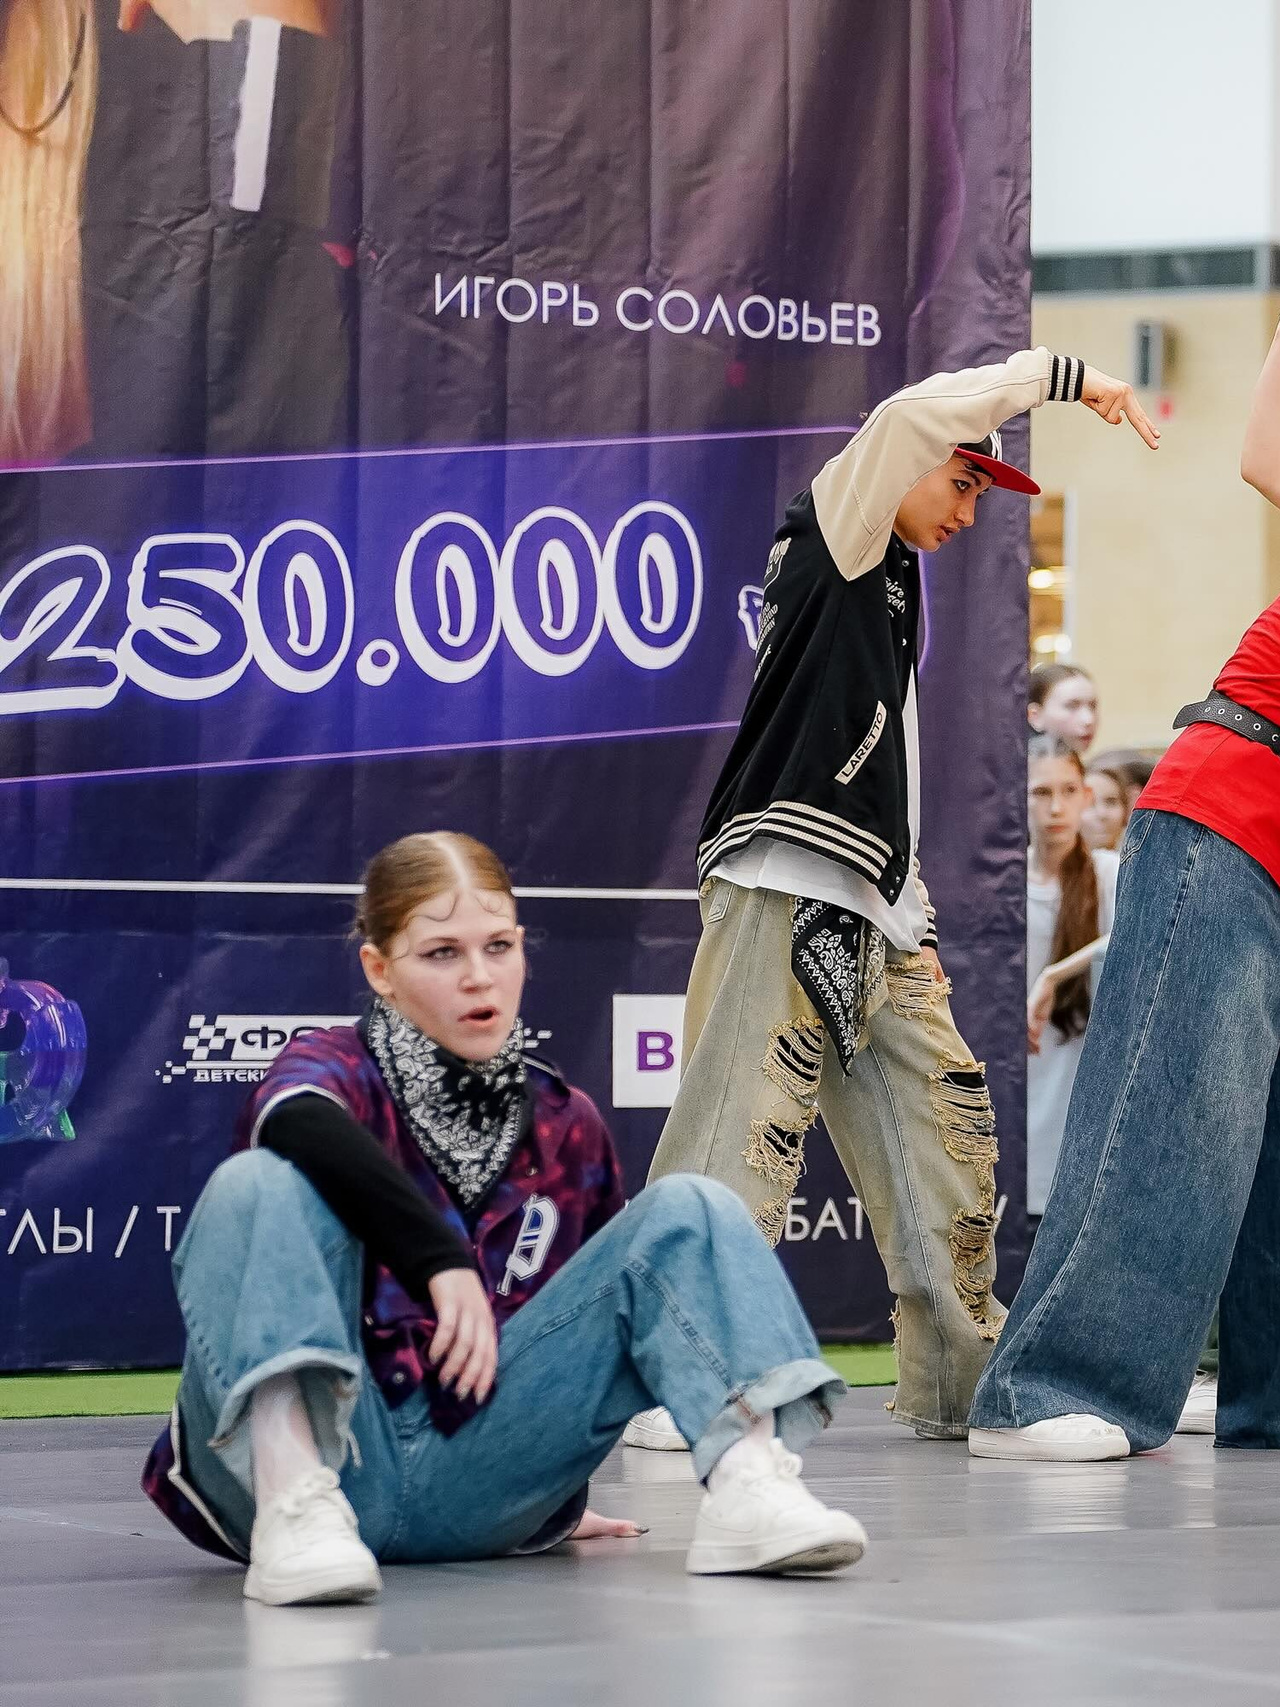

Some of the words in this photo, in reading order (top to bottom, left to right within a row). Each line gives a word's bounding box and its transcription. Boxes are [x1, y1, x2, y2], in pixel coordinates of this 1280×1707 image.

[434, 273, 600, 327] ИГОРЬ
[616, 286, 882, 347] СОЛОВЬЕВ
[0, 500, 703, 713] 250.000
[841, 712, 882, 778] LARETTO
[193, 1069, 268, 1083] ДЕТСКИ
[0, 1206, 94, 1255] ЛЫ
[784, 1196, 865, 1242] БАТ
